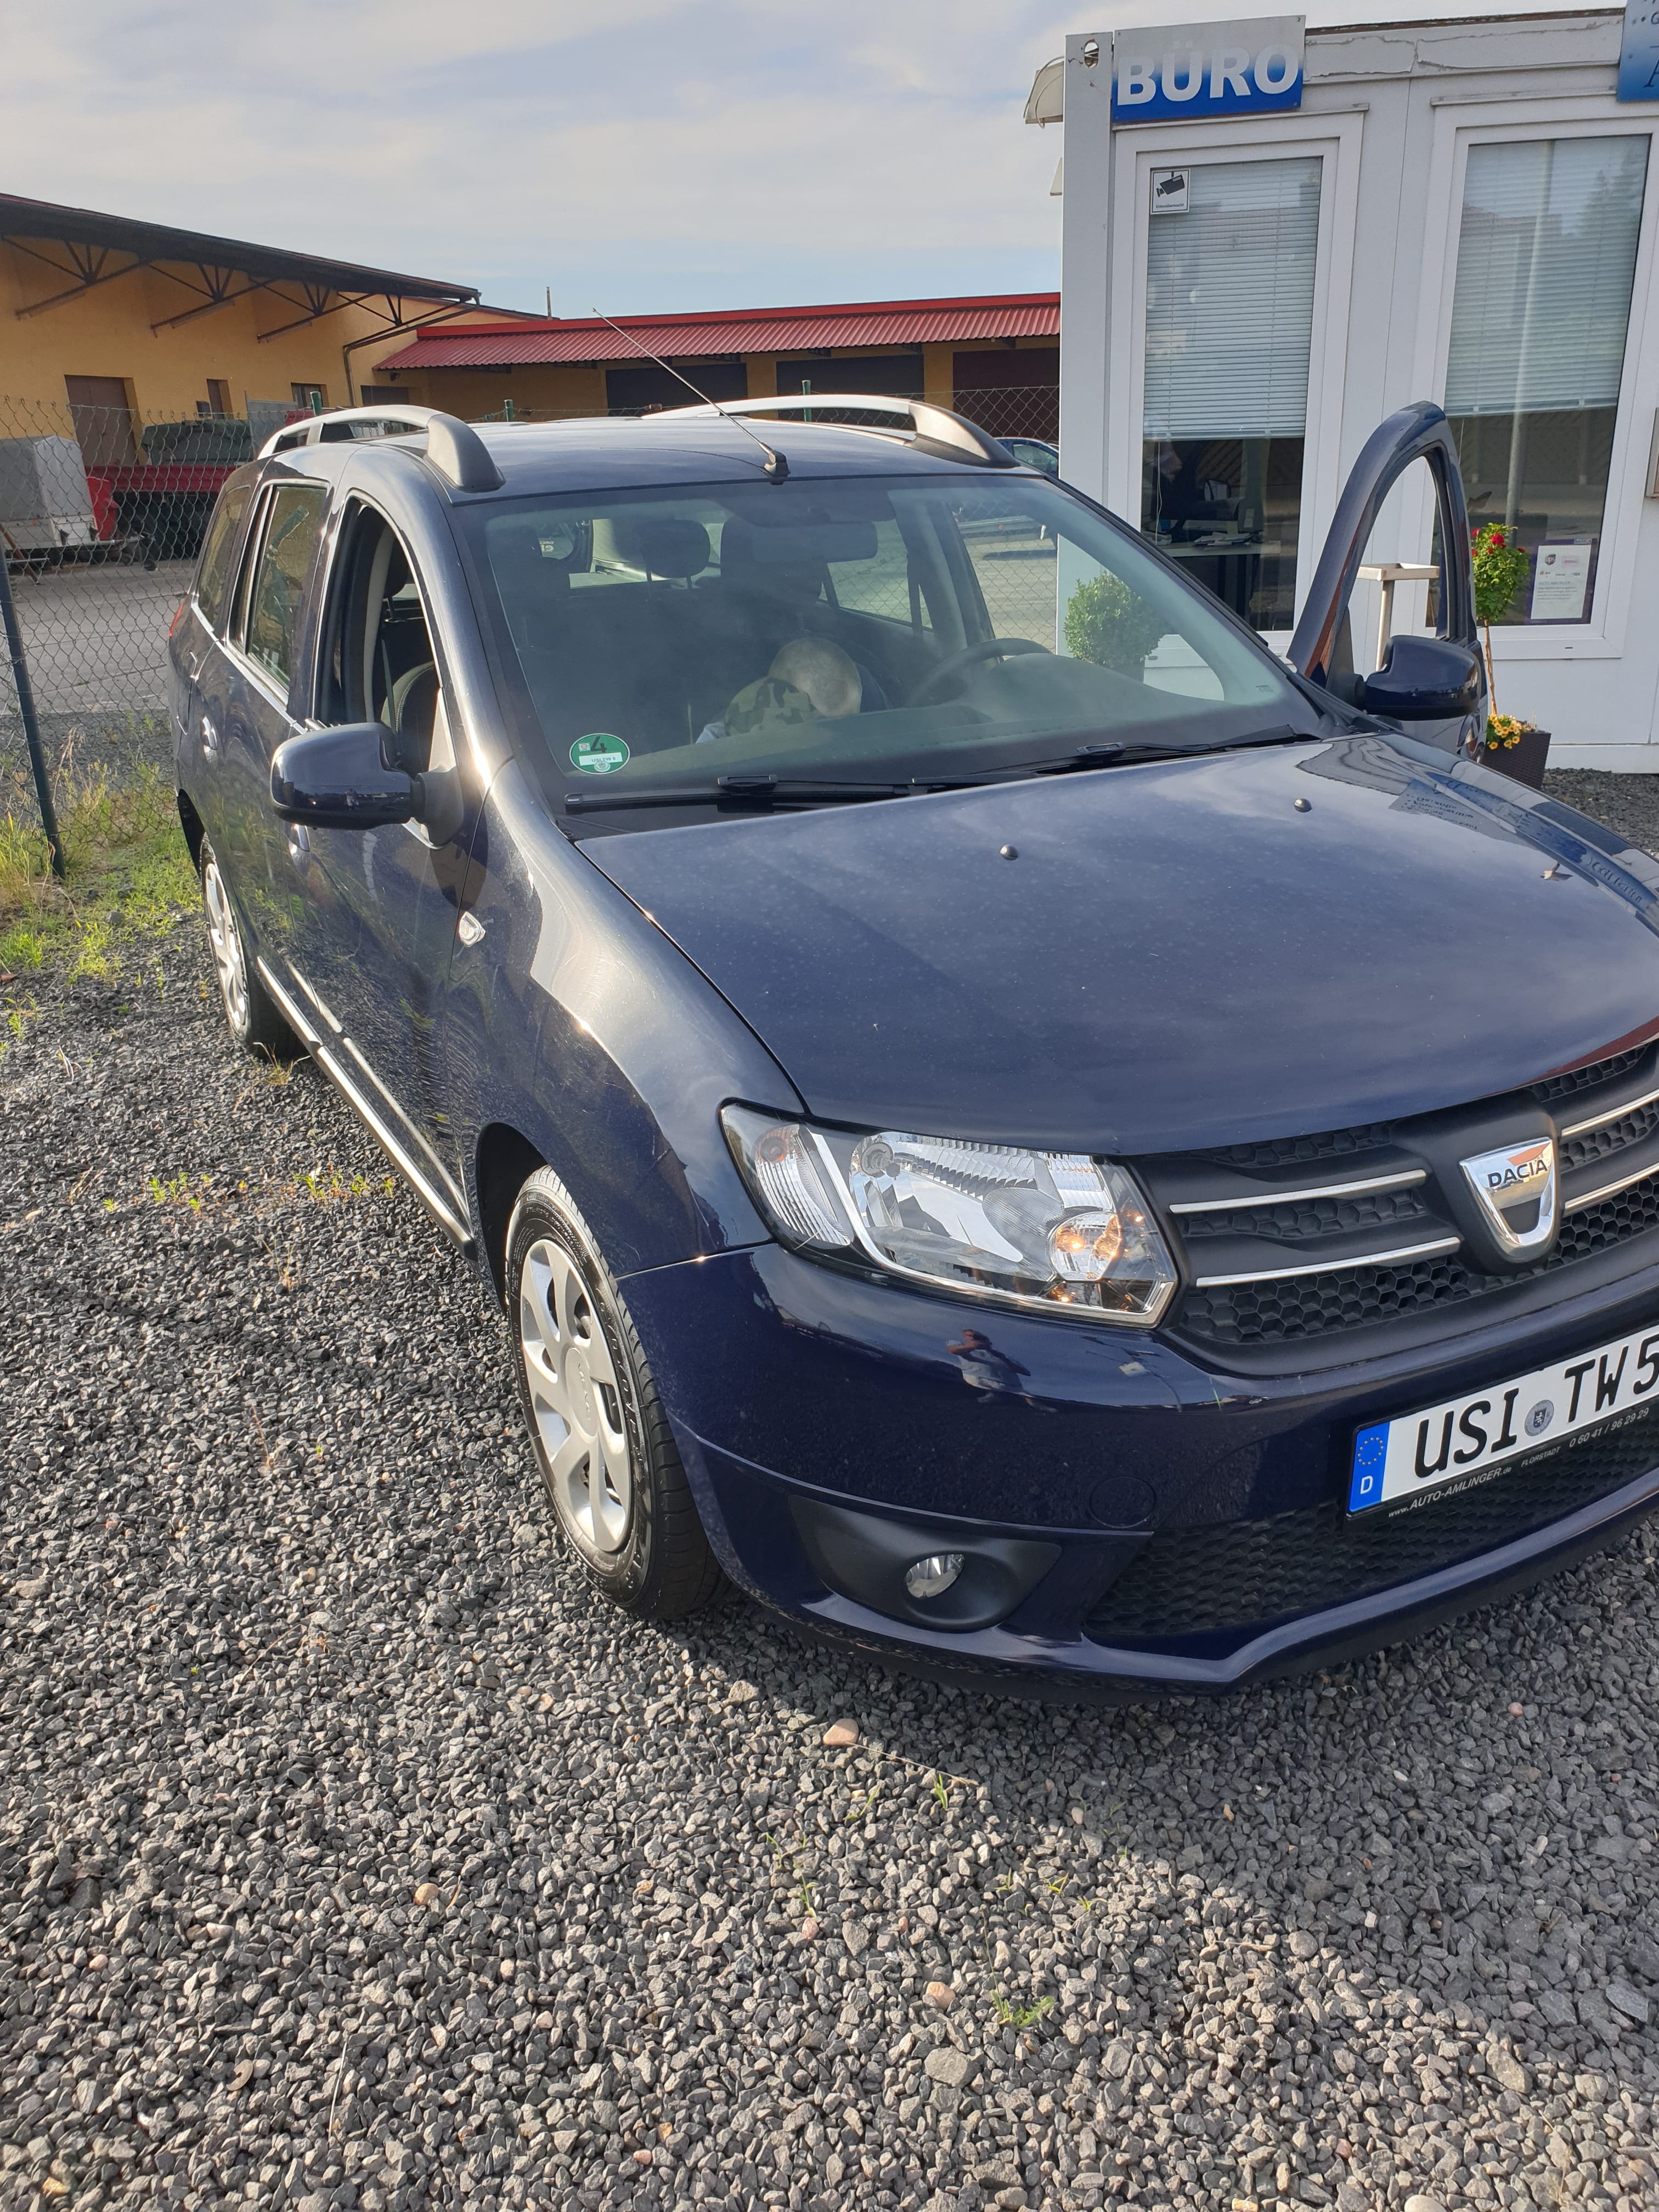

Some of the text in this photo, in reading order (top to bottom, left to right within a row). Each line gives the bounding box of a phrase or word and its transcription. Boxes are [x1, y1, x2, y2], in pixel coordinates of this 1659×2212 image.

[1117, 41, 1299, 105] BÜRO
[590, 736, 607, 753] 4
[1487, 1159, 1548, 1187] DACIA
[1414, 1387, 1519, 1479] USI
[1564, 1345, 1629, 1423] TW
[1389, 1466, 1511, 1517] www.AUTO-AMLINGER.de
[1521, 1446, 1561, 1467] FLORSTADT
[1569, 1438, 1576, 1448] 0
[1577, 1432, 1590, 1444] 60
[1592, 1429, 1602, 1438] 41
[1611, 1419, 1623, 1431] 96
[1624, 1413, 1636, 1425] 29
[1637, 1407, 1649, 1420] 29
[1360, 1476, 1373, 1495] D
